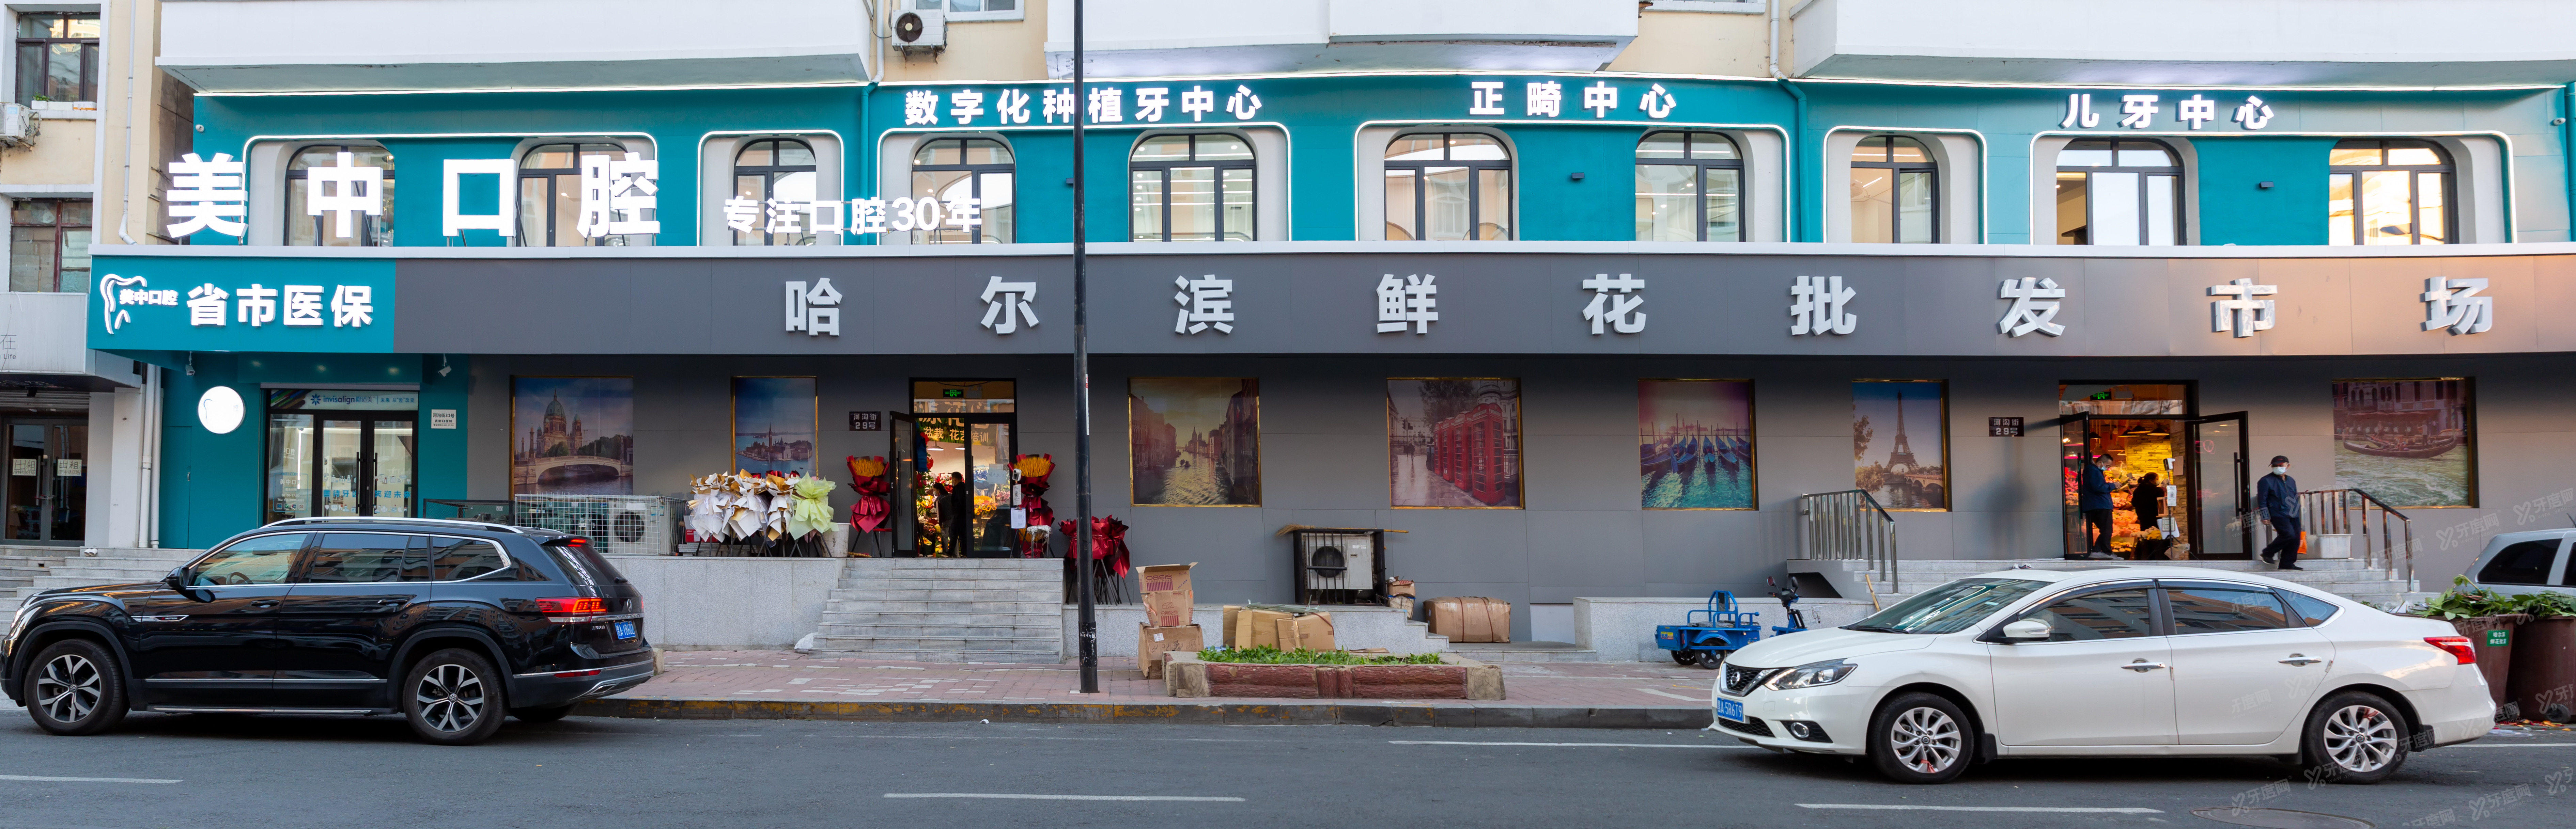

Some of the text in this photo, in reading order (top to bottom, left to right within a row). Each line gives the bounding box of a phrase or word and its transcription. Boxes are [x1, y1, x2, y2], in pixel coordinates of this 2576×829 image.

[905, 85, 1262, 126] 数字化种植牙中心
[1469, 80, 1677, 119] 正畸中心
[2060, 94, 2274, 130] 儿牙中心
[167, 151, 661, 239] 美中口腔
[723, 195, 982, 235] 专注口腔30年
[120, 289, 179, 305] 美中口腔
[186, 283, 374, 327] 省市医保
[785, 273, 2494, 338] 哈尔滨鲜花批发市场
[323, 396, 355, 404] invisalign
[924, 427, 944, 440] 盆栽
[15, 460, 35, 471] 出租
[59, 460, 78, 469] 出租
[375, 490, 411, 498] 笑迎未来
